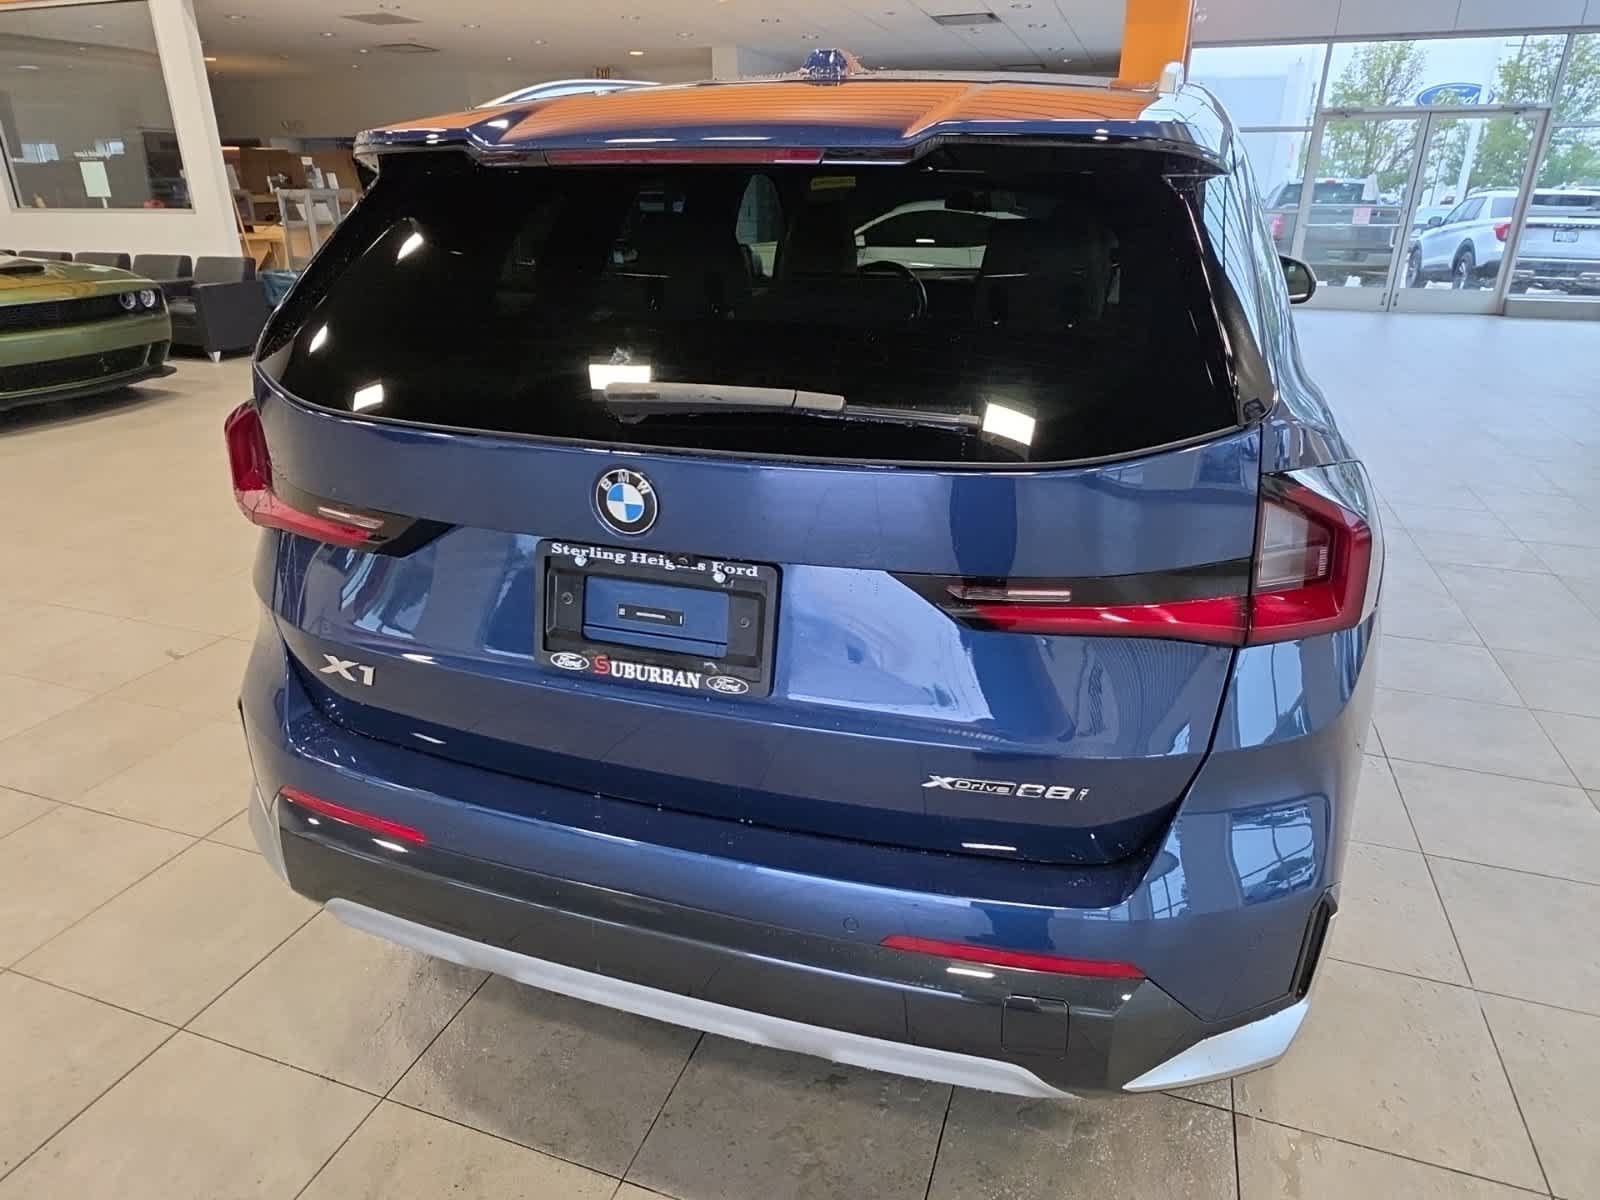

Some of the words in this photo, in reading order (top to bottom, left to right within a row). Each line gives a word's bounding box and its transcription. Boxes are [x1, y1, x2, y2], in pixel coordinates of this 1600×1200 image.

[1426, 85, 1482, 105] Ford
[551, 542, 625, 565] Sterling
[630, 551, 706, 572] Heigs
[711, 561, 759, 578] Ford
[319, 653, 376, 687] X1
[554, 653, 586, 669] Ford
[593, 655, 702, 689] SUBURBAN
[709, 676, 744, 693] Ford
